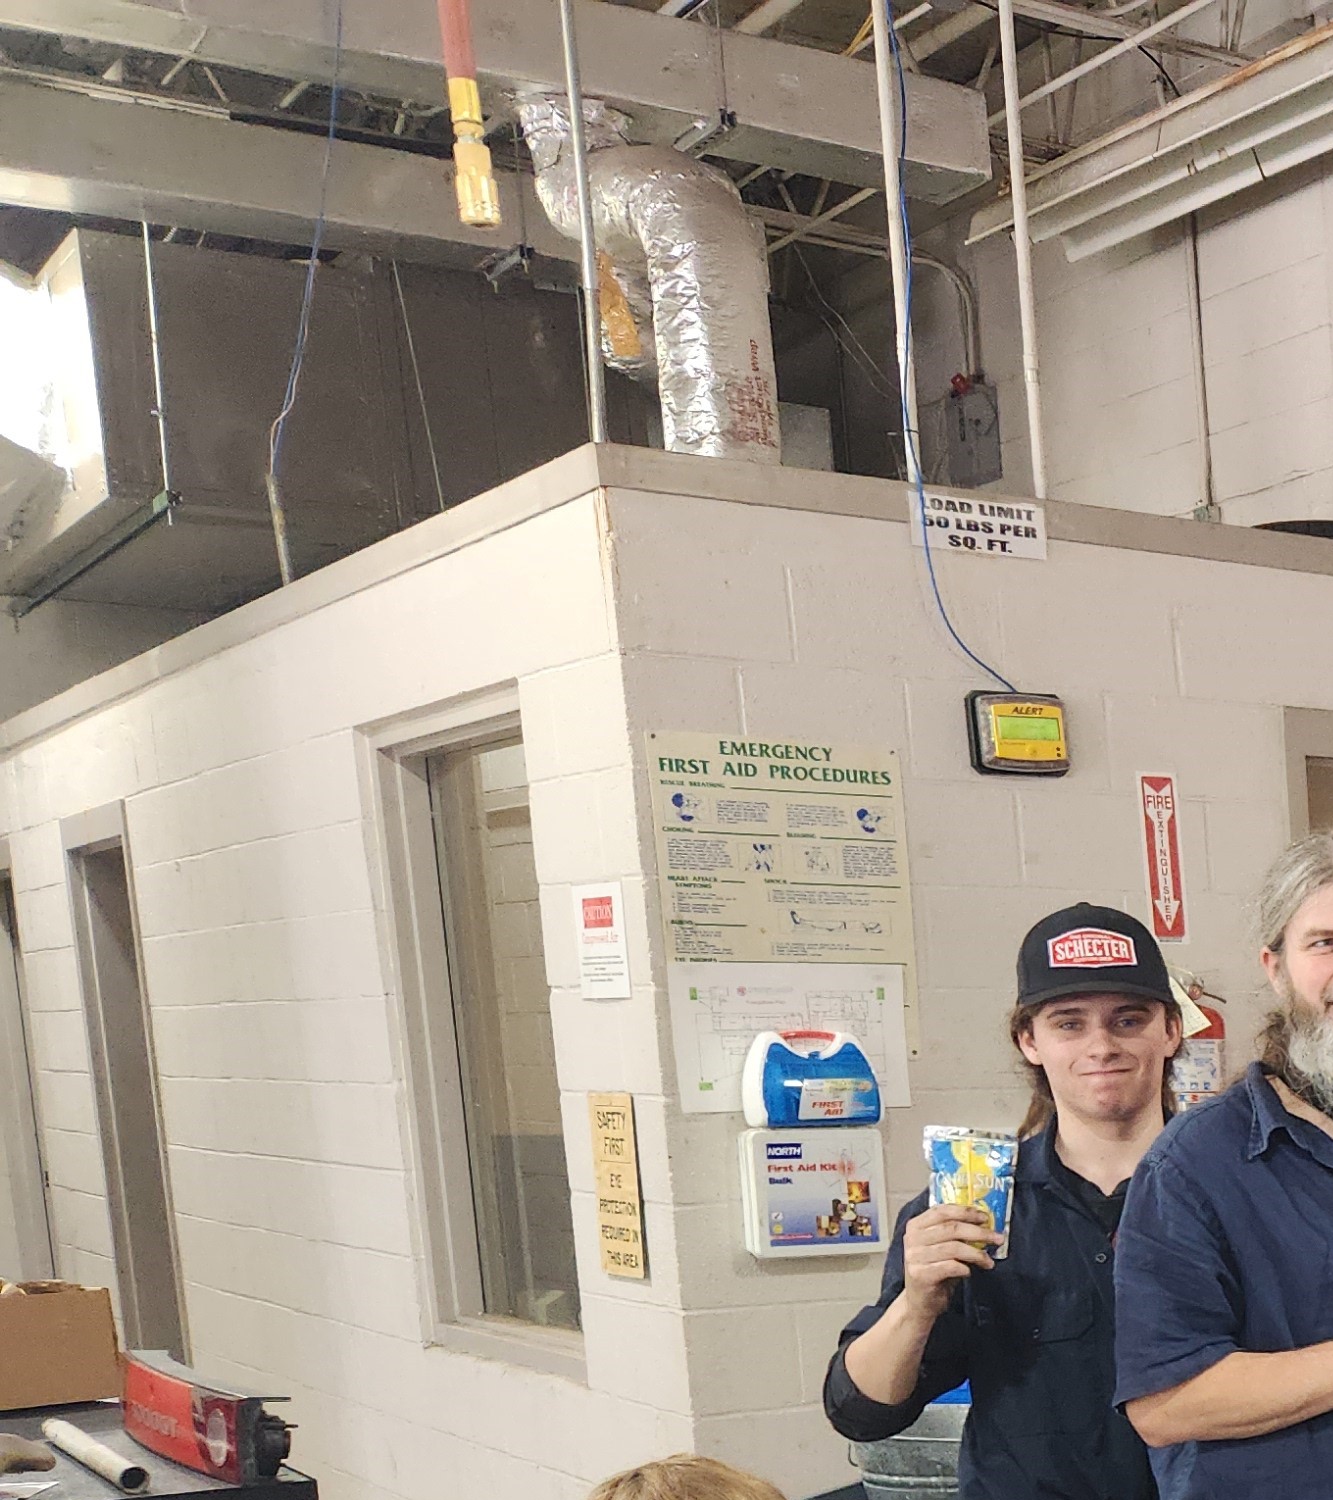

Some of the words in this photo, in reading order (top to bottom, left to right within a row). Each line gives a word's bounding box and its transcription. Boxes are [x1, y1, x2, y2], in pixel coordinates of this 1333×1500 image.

[978, 503, 1035, 522] LIMIT
[955, 518, 994, 535] LBS
[999, 523, 1037, 540] PER
[948, 534, 983, 551] SQ.
[987, 539, 1013, 554] FT.
[1011, 706, 1044, 716] ALERT
[718, 740, 833, 763] EMERGENCY
[658, 757, 710, 776] FIRST
[722, 762, 758, 778] AID
[769, 765, 892, 786] PROCEDURES
[1146, 795, 1172, 811] FIRE
[1157, 811, 1173, 922] EXTINGUISHER
[1054, 938, 1131, 961] SCHECTER
[596, 1111, 627, 1130] SAFETY
[603, 1137, 625, 1156] FIRST
[768, 1146, 801, 1156] NORTH
[767, 1163, 794, 1173] First
[798, 1163, 817, 1172] Aid
[820, 1162, 838, 1172] Kit
[973, 1173, 1005, 1193] SUN
